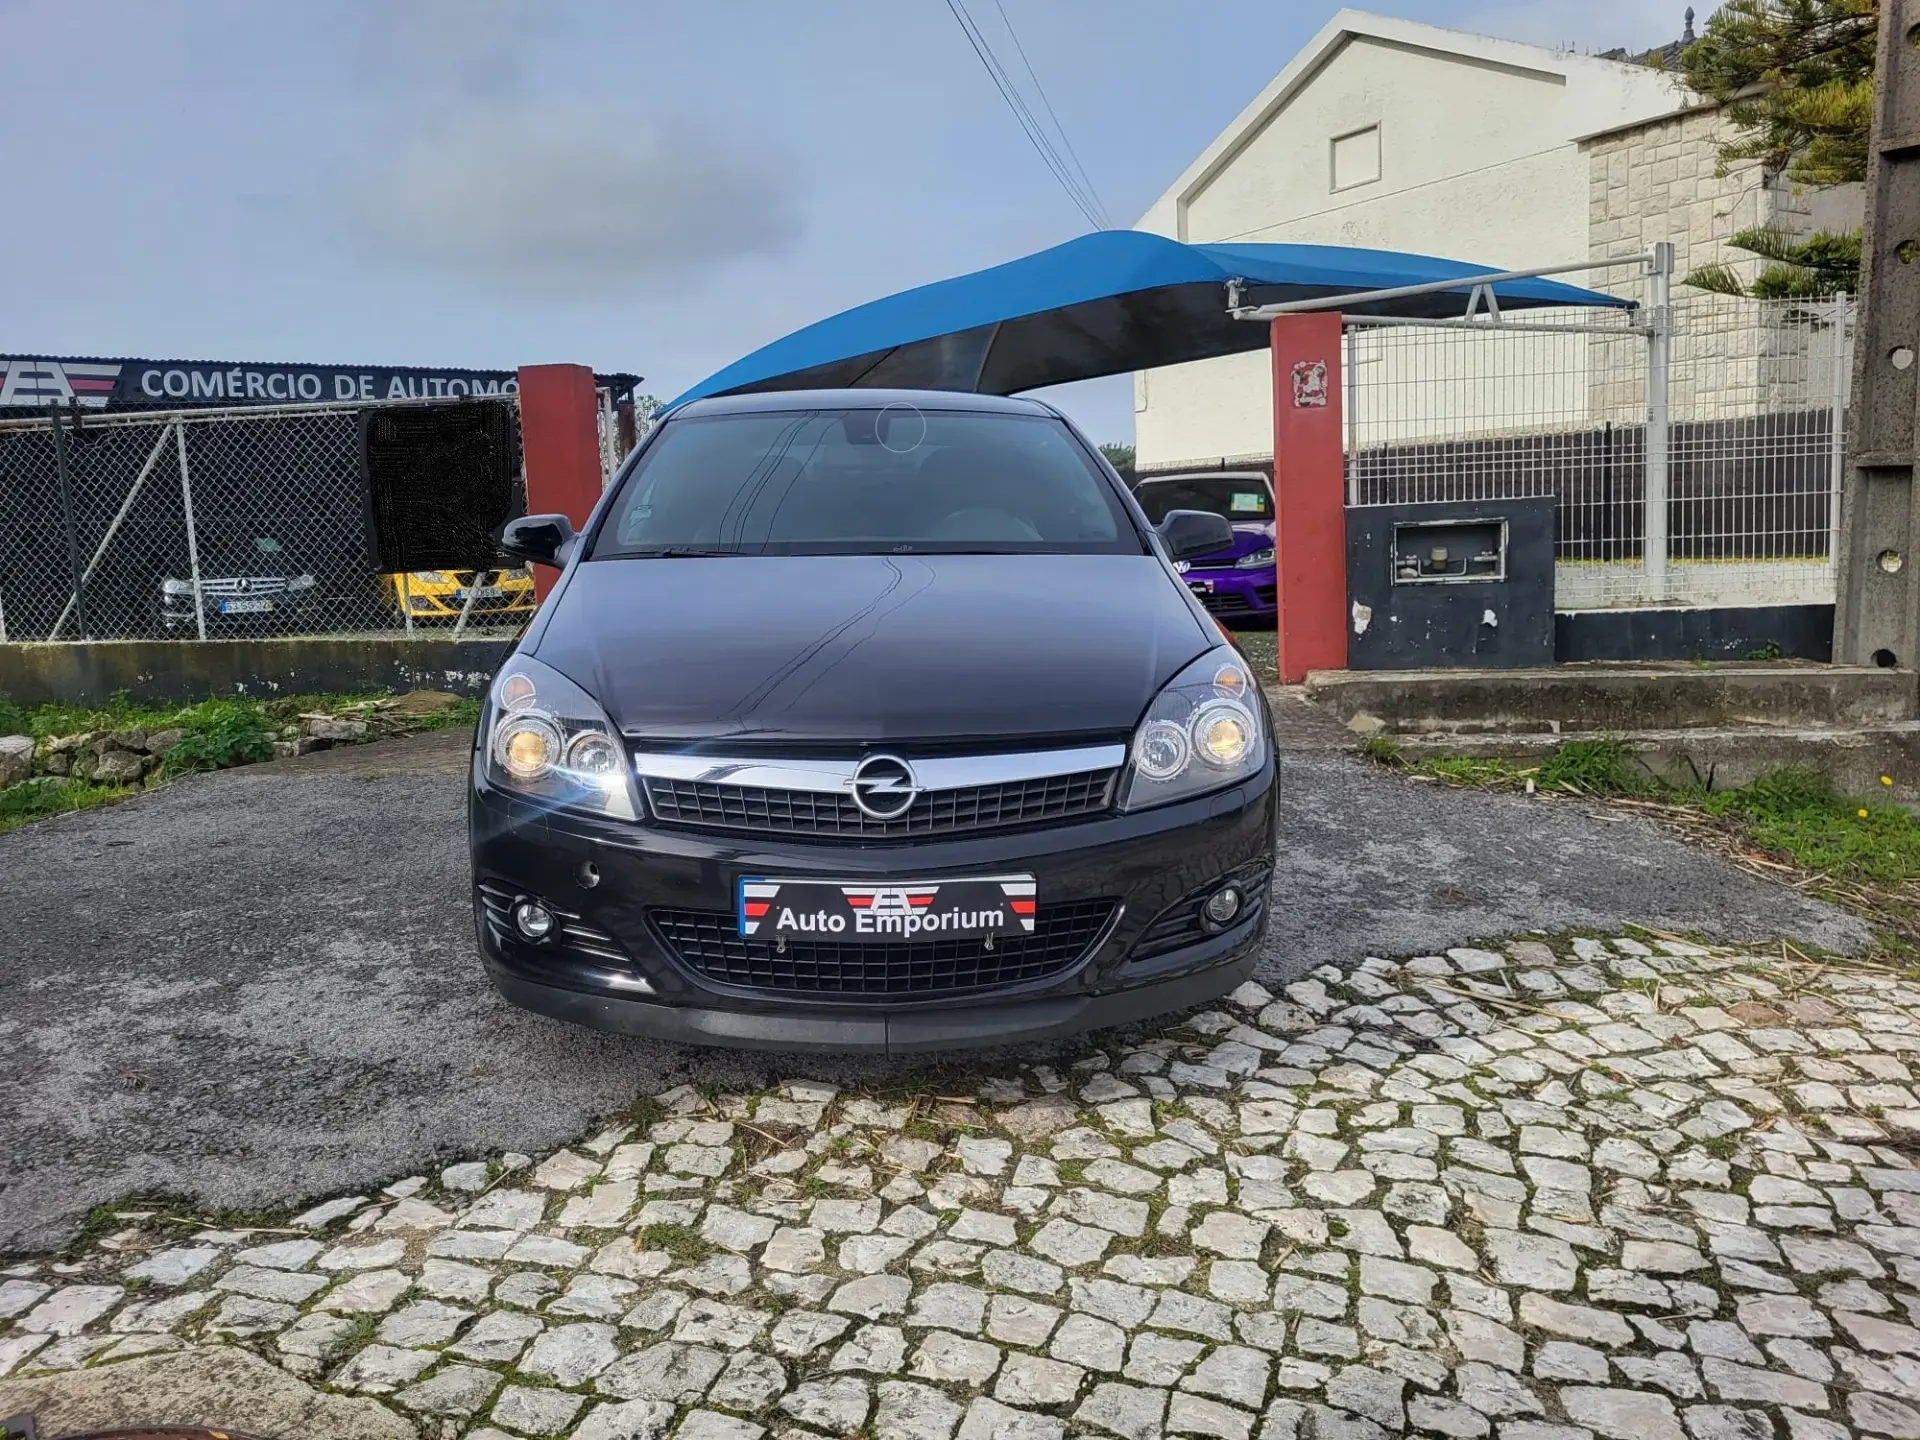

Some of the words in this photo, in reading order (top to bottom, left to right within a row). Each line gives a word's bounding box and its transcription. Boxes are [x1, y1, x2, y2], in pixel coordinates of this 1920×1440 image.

[141, 367, 322, 400] COMÉRCIO
[334, 374, 376, 400] DE
[776, 907, 846, 933] Auto
[855, 906, 1004, 938] Emporium
